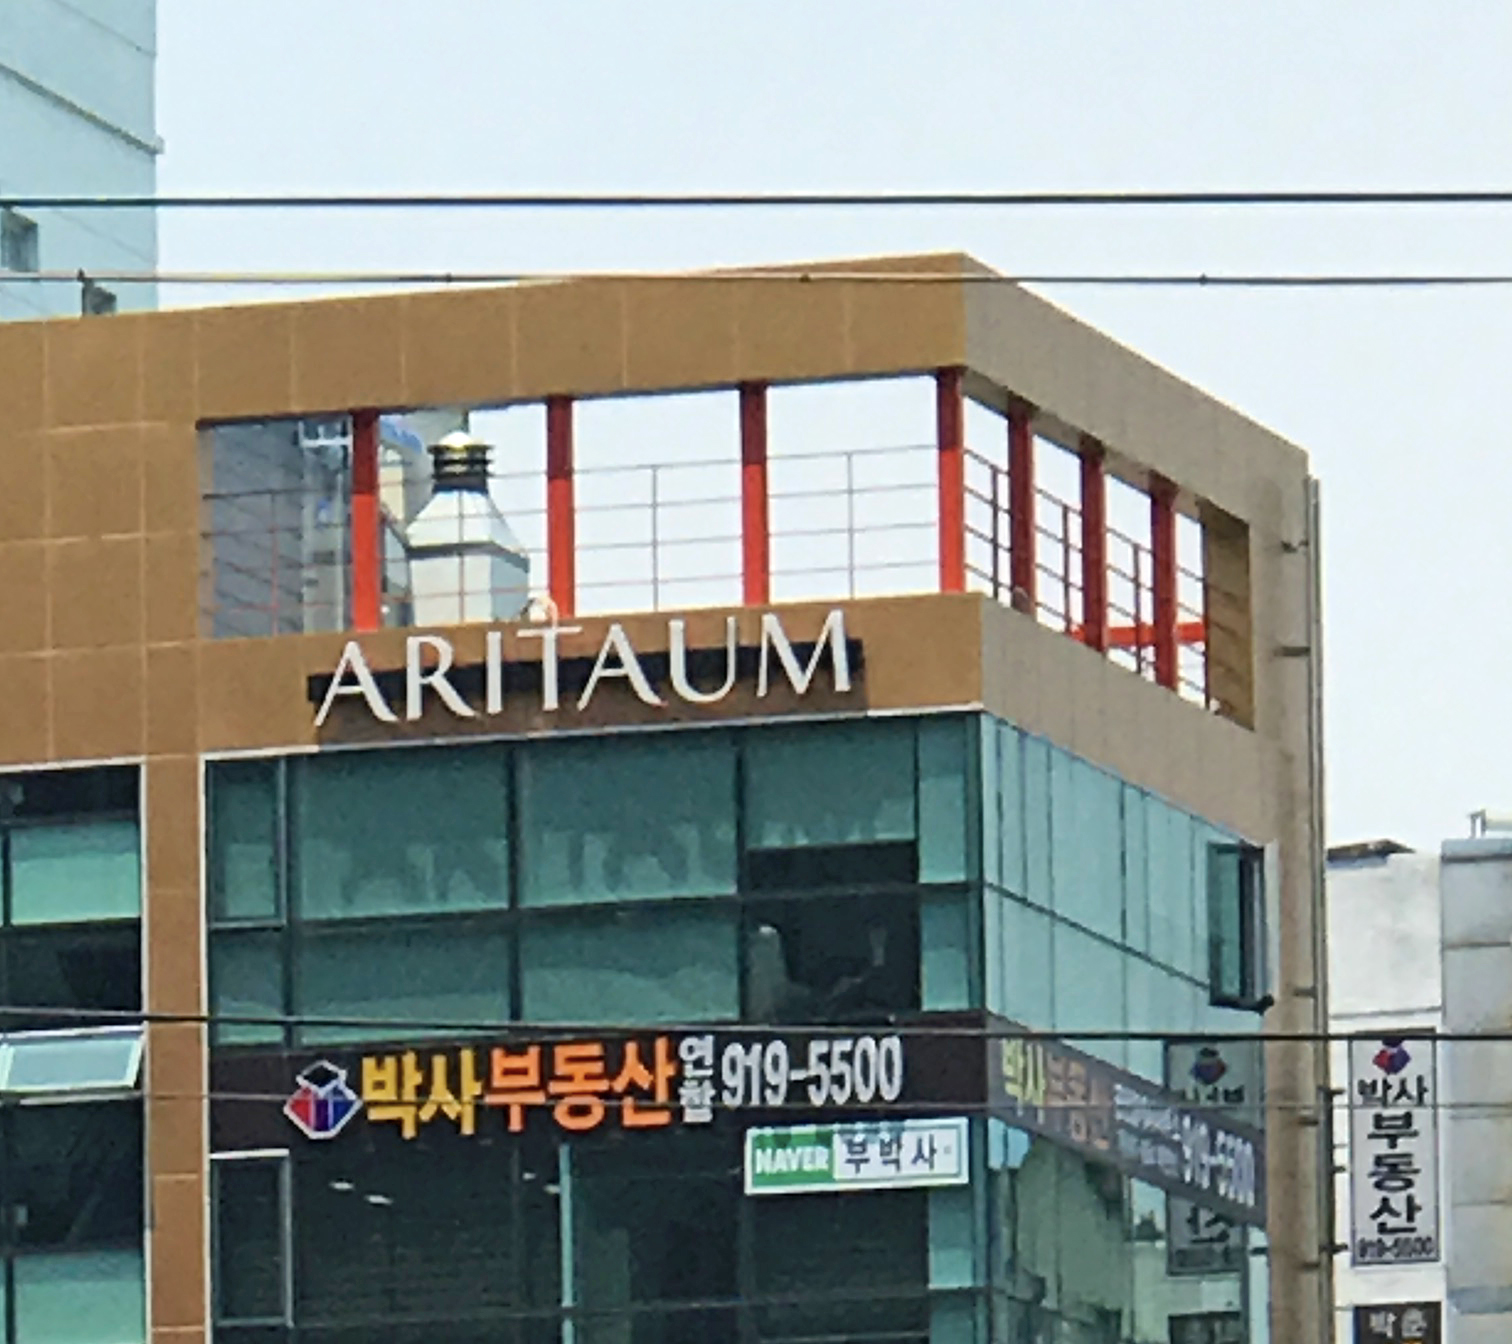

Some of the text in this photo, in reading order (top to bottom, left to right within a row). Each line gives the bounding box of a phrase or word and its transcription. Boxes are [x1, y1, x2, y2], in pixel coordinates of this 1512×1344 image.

[314, 609, 851, 726] ARITAUM
[721, 1036, 903, 1107] 919-5500
[756, 1146, 829, 1174] NAVER
[1367, 1111, 1423, 1235] 부동산
